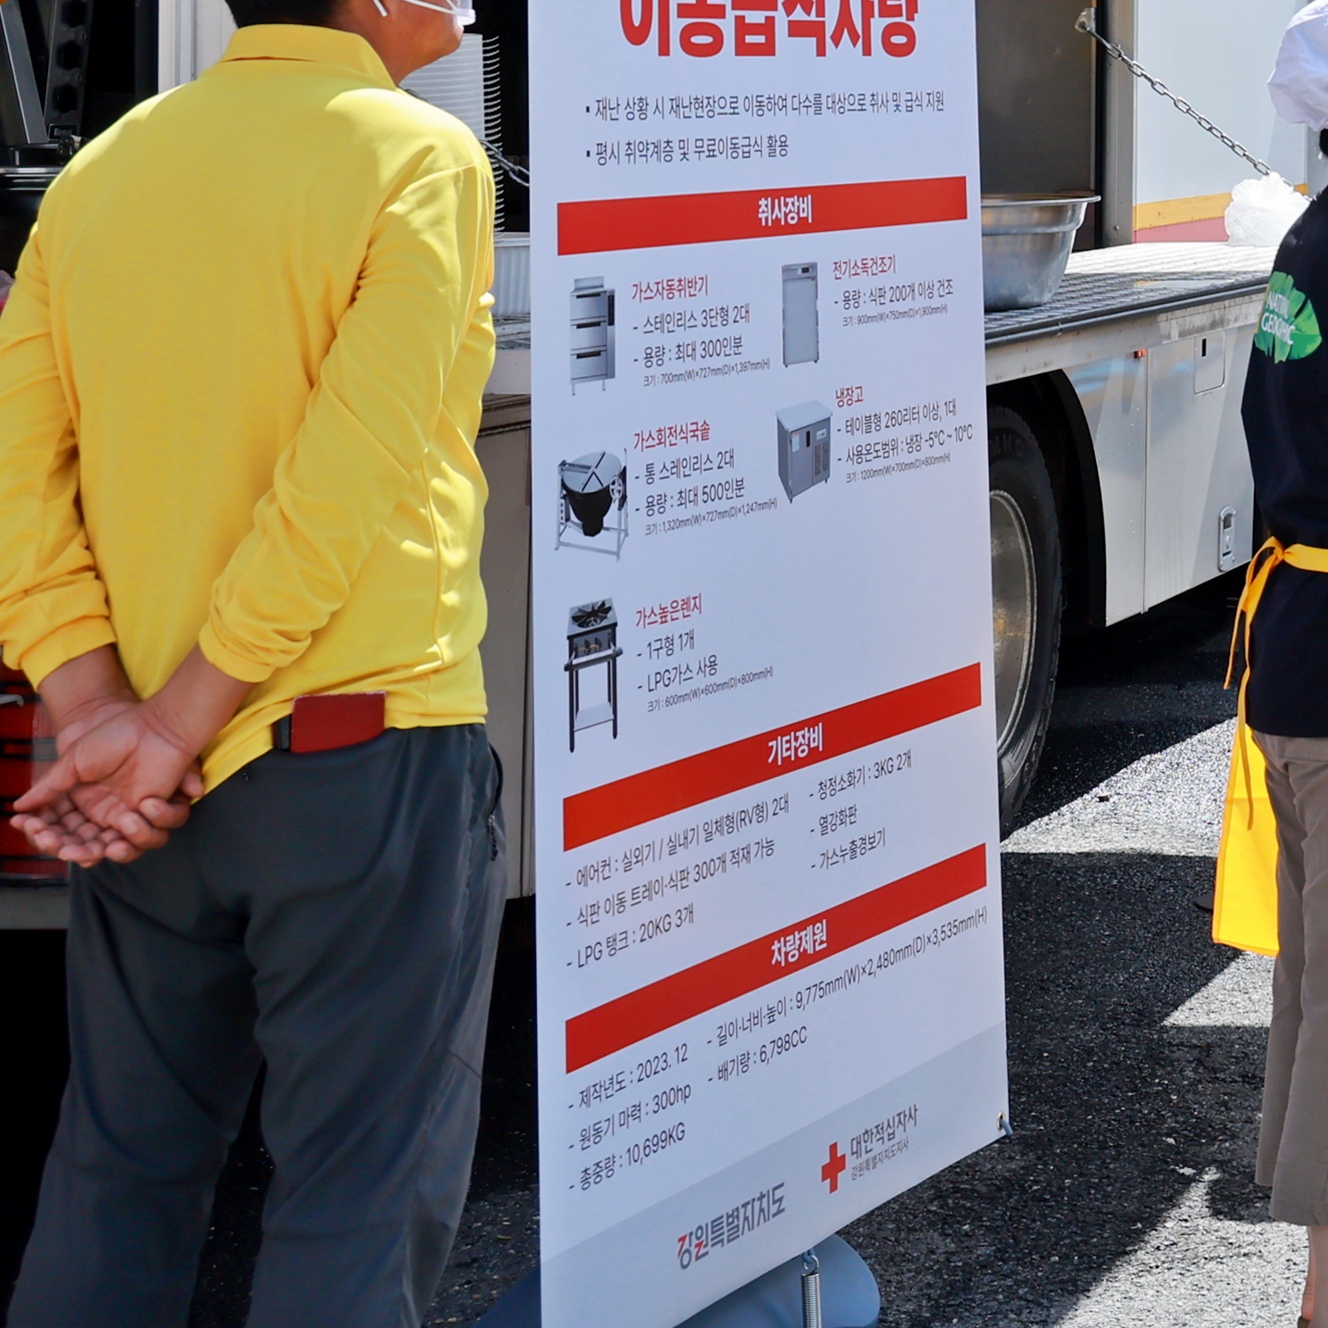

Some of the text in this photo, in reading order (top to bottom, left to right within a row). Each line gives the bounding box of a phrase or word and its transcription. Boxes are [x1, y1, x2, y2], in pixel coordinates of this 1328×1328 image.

[595, 90, 944, 121] 재난 상황 시 재난현장으로 이동하여 다수를 대상으로 취사 및 급식 지원
[595, 134, 789, 166] 평시 취약계층 및 무료이동급식 활용
[758, 195, 812, 226] 취사장비
[833, 255, 896, 280] 전기소독건조기
[632, 275, 709, 303] 가스자동취반기
[842, 278, 954, 311] 용량 식판 200개 이상 건조
[643, 303, 749, 335] 스테인리스 3단형 2대
[643, 334, 743, 369] 용량 최대 300인분
[835, 385, 864, 409] 냉장고
[634, 421, 710, 453] 가스회전식국솥
[845, 411, 882, 437] 테이블형
[884, 405, 920, 430] 260리터
[944, 398, 956, 420] 1대
[644, 462, 656, 486] 통
[717, 447, 734, 469] 2대
[845, 438, 900, 465] 사용온도범위
[905, 433, 923, 455] 냉장
[644, 477, 745, 518] 용량 최대 500인분
[636, 593, 703, 630] 가스높은렌지
[646, 629, 695, 660] 1구형 1개
[647, 654, 719, 693] LPG가스 사용
[767, 722, 823, 766] 기타장비
[817, 749, 912, 802] 청정소화기 3KG 2개
[818, 804, 858, 837] 열강화판
[577, 792, 789, 889] 에어컨 실외기 실내기 일체형(RV형) 2대
[819, 826, 886, 870] 가스누출경보기
[577, 898, 600, 927] 식판
[603, 889, 626, 916] 이동
[693, 851, 727, 883] 300개
[729, 843, 751, 870] 적재
[753, 835, 775, 861] 가능
[577, 901, 694, 968] LPG 탱크 20KG 3개
[771, 918, 827, 967] 차량제원
[717, 1026, 808, 1083] 배기량 6,798CC
[579, 1042, 689, 1111] 제작년도 2023. 12
[579, 1083, 692, 1152] 원동기 마력 300hp
[850, 1104, 919, 1157] 대한적십자사
[579, 1121, 687, 1192] 총중량 10,699KG
[677, 1182, 786, 1270] 강원특별자치도
